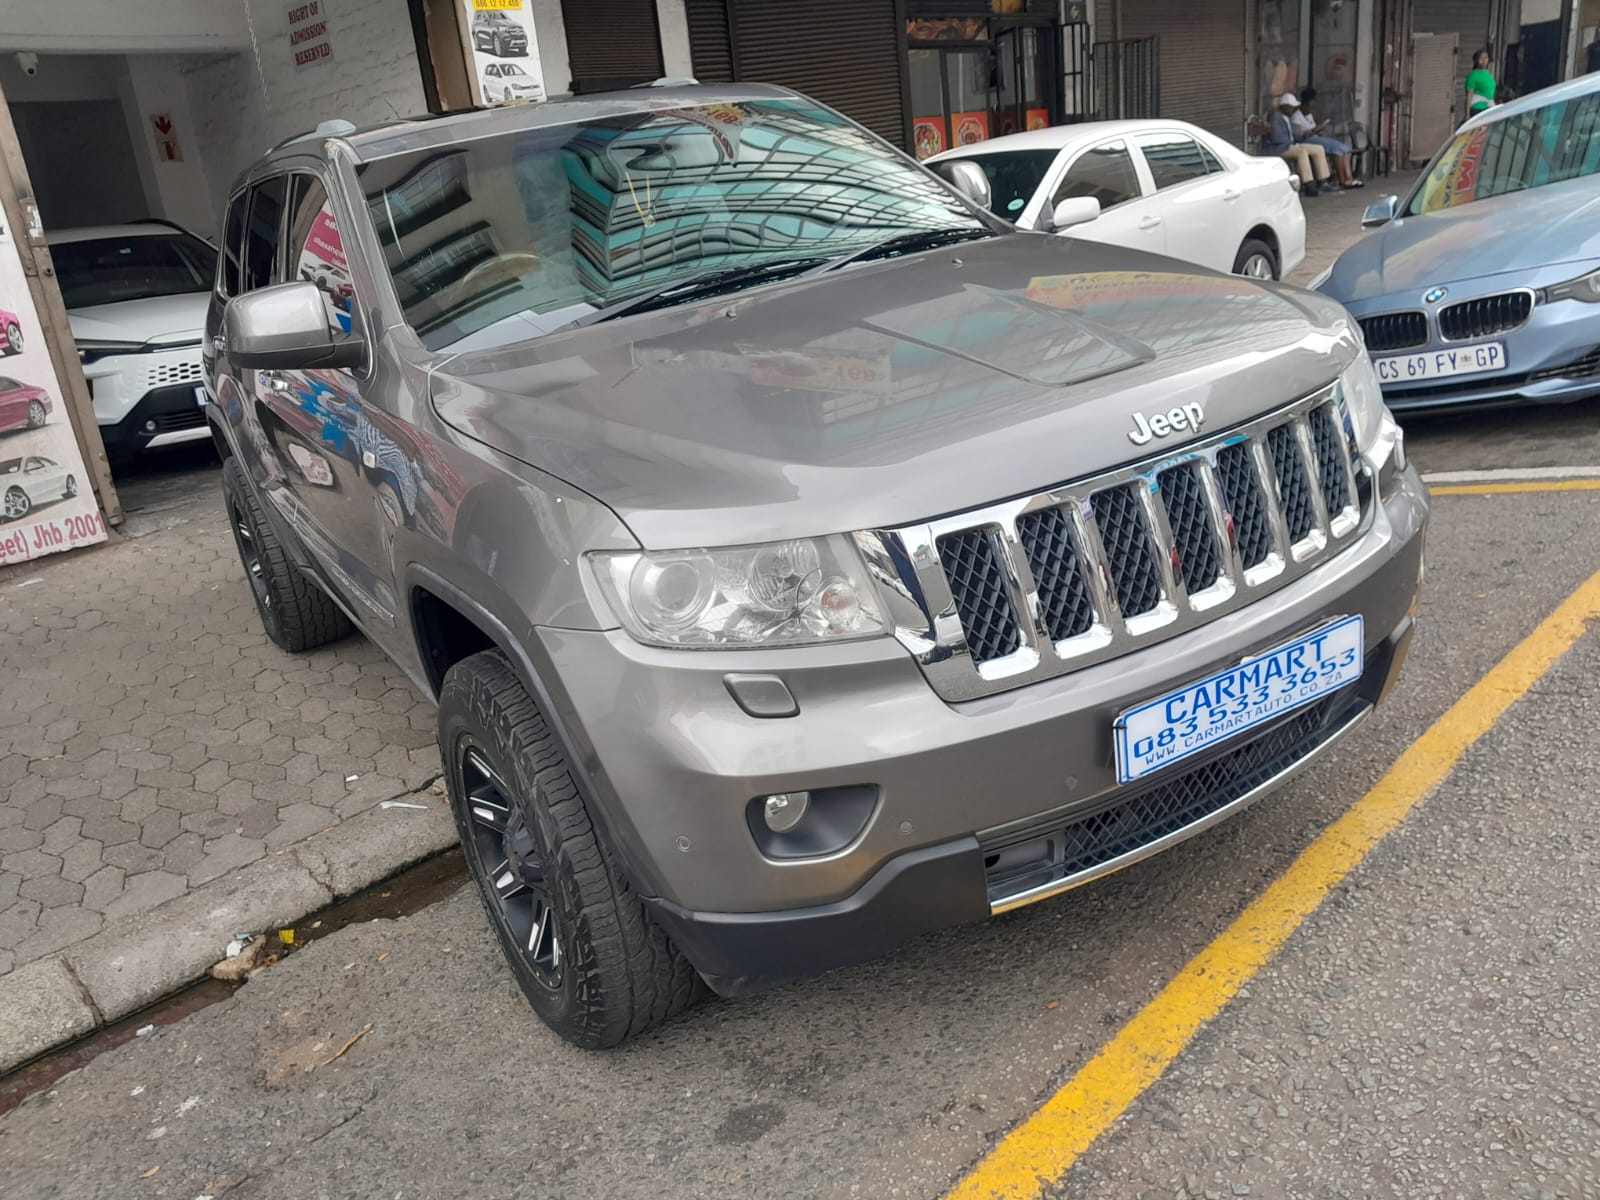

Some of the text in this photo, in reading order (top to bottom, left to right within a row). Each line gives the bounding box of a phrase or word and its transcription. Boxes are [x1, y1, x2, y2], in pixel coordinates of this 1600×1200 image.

[288, 1, 319, 24] RIGHT OF
[290, 21, 327, 46] ADMISSION
[295, 42, 330, 66] RESERVED
[1379, 346, 1498, 379] CS 69 FY GP
[1128, 401, 1204, 446] Jeep
[33, 522, 63, 549] Jhb
[65, 512, 106, 541] 2001
[1165, 635, 1328, 724] CARMART
[1325, 671, 1343, 685] ZA
[1133, 648, 1356, 758] 083 533 3653
